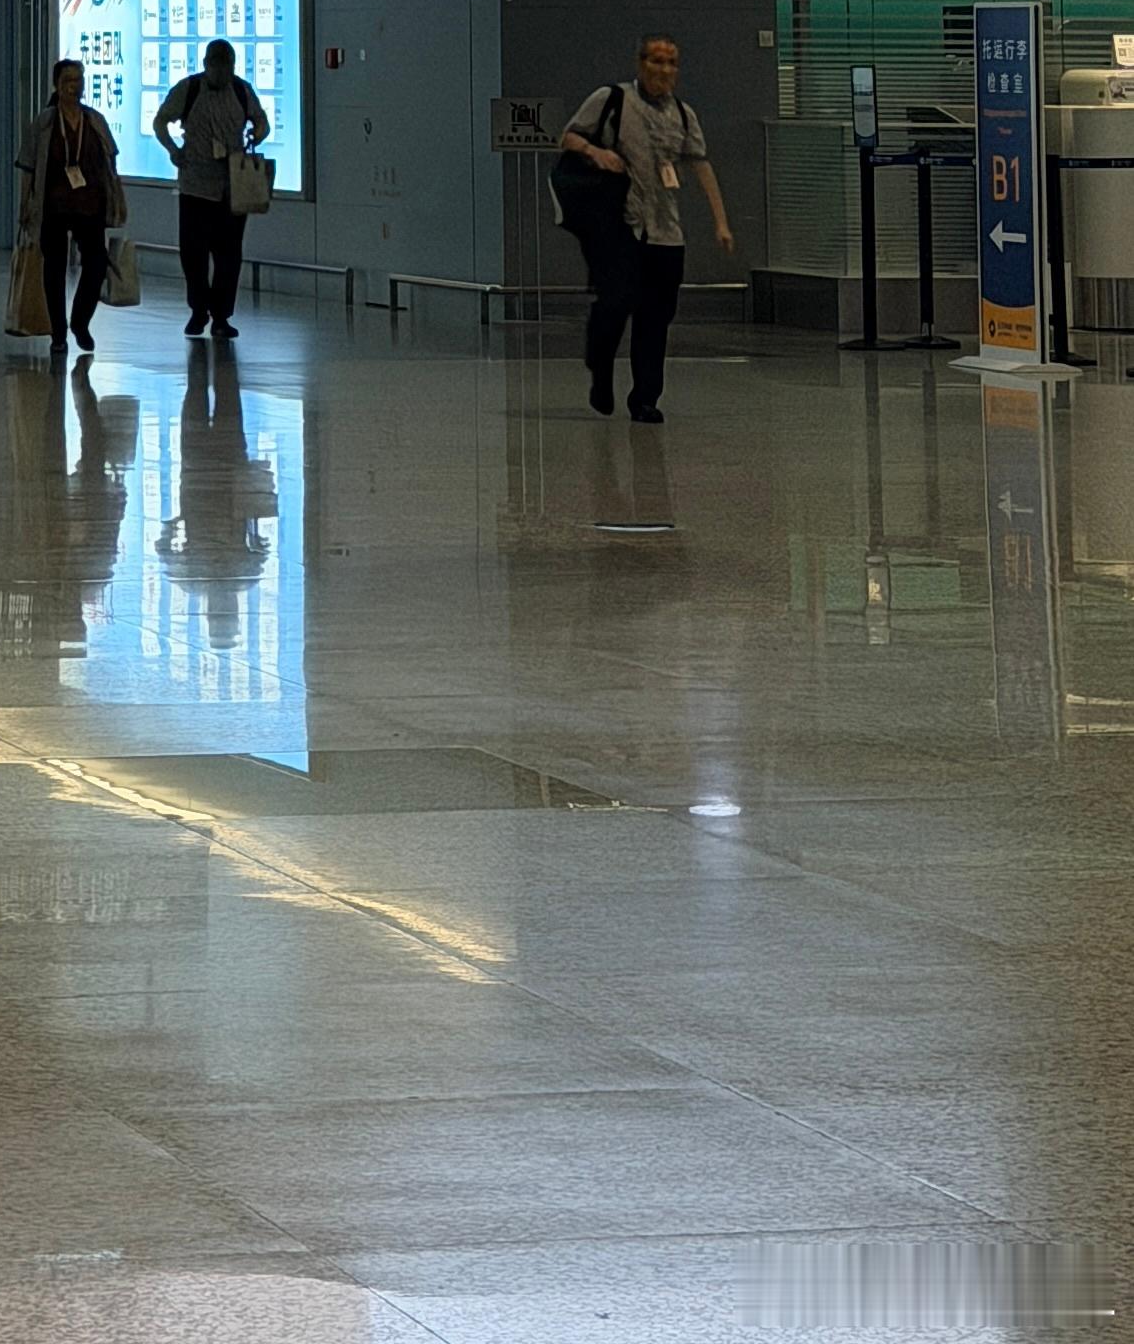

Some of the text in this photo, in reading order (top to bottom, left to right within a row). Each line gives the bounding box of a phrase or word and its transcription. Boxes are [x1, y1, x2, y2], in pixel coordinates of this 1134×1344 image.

[80, 30, 124, 66] 先进团队
[981, 38, 1028, 62] 托运行李
[82, 72, 123, 110] 用飞书
[985, 72, 1024, 94] 检查室
[991, 155, 1022, 202] B1
